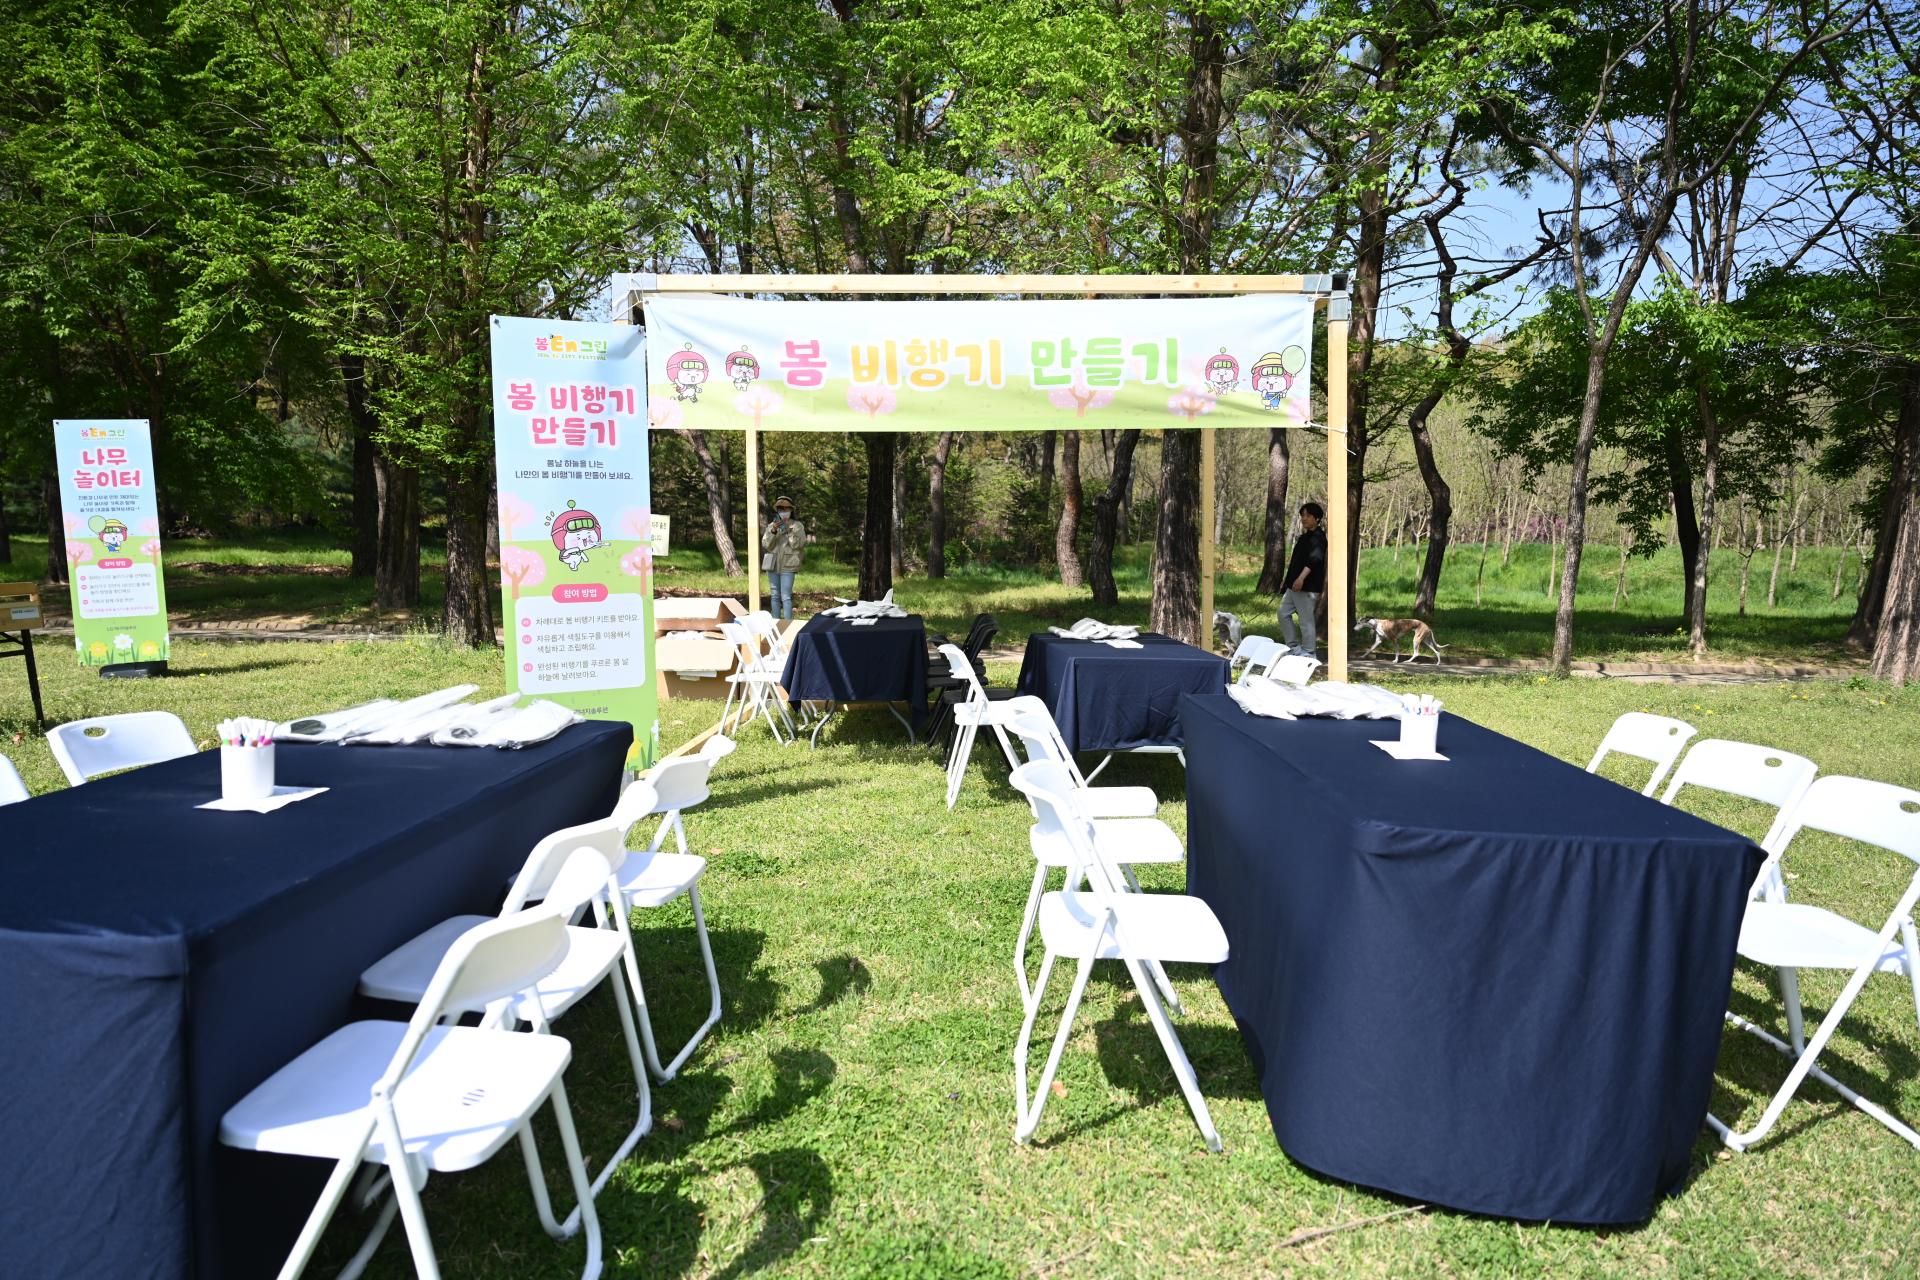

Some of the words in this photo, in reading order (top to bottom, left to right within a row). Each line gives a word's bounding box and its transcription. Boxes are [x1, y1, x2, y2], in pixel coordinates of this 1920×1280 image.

[780, 340, 827, 386] 봄
[851, 338, 1001, 387] 비행기
[1031, 337, 1177, 386] 만들기
[507, 382, 536, 411] 봄
[550, 385, 635, 414] 비행기
[531, 416, 616, 446] 만들기
[82, 448, 127, 465] 나무
[564, 459, 586, 468] 하늘을
[588, 460, 604, 469] 나는
[74, 469, 141, 489] 놀이터
[515, 470, 539, 479] 나만의
[542, 471, 549, 479] 봄
[551, 470, 582, 480] 비행기를
[584, 471, 607, 480] 만들어
[608, 472, 633, 480] 보세요.
[563, 589, 579, 598] 참여
[581, 588, 597, 598] 방법
[536, 616, 564, 626] 차례대로
[574, 615, 595, 625] 비행기
[537, 633, 565, 643] 자유롭게
[567, 631, 601, 642] 색칠도구를
[603, 630, 631, 640] 이용해서
[537, 644, 565, 654] 색칠하고
[537, 661, 560, 671] 완성된
[561, 660, 589, 670] 비행기를
[538, 672, 560, 682] 하늘에
